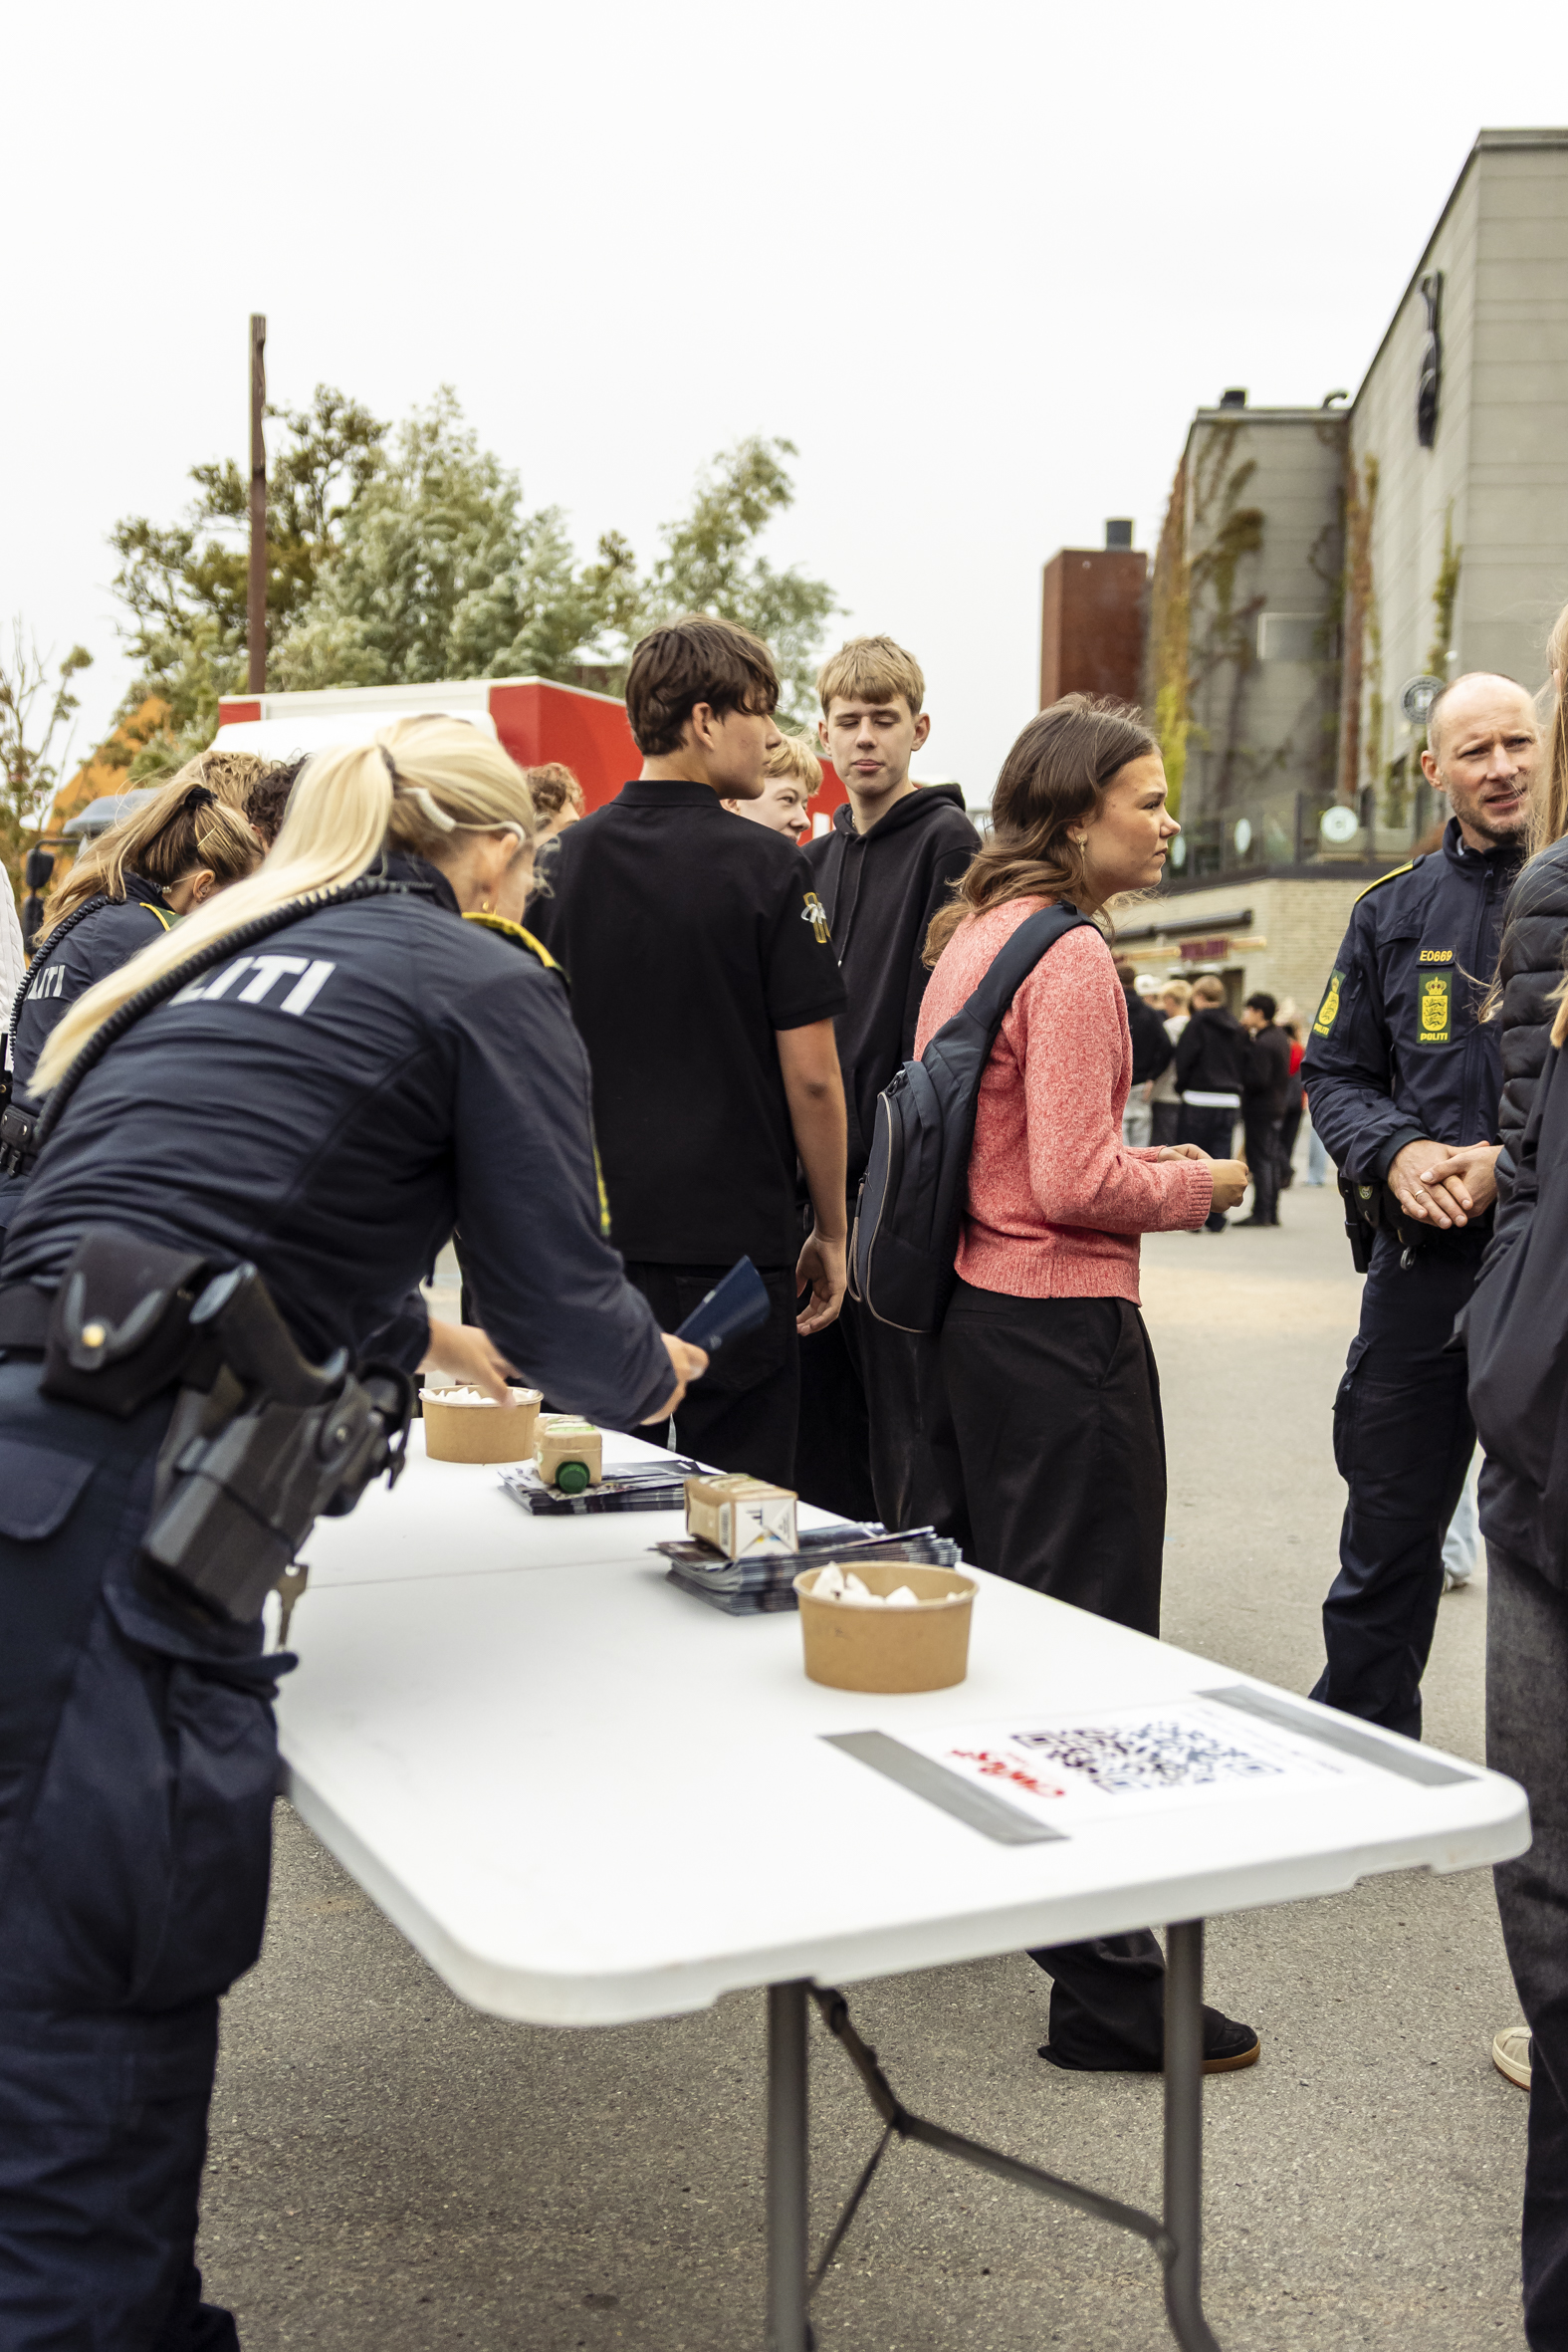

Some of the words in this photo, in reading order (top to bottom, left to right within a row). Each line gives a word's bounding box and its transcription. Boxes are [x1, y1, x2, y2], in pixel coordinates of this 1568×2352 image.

[26, 964, 66, 1000] LITI
[167, 954, 337, 1017] LITI
[1420, 1032, 1449, 1042] POLITI
